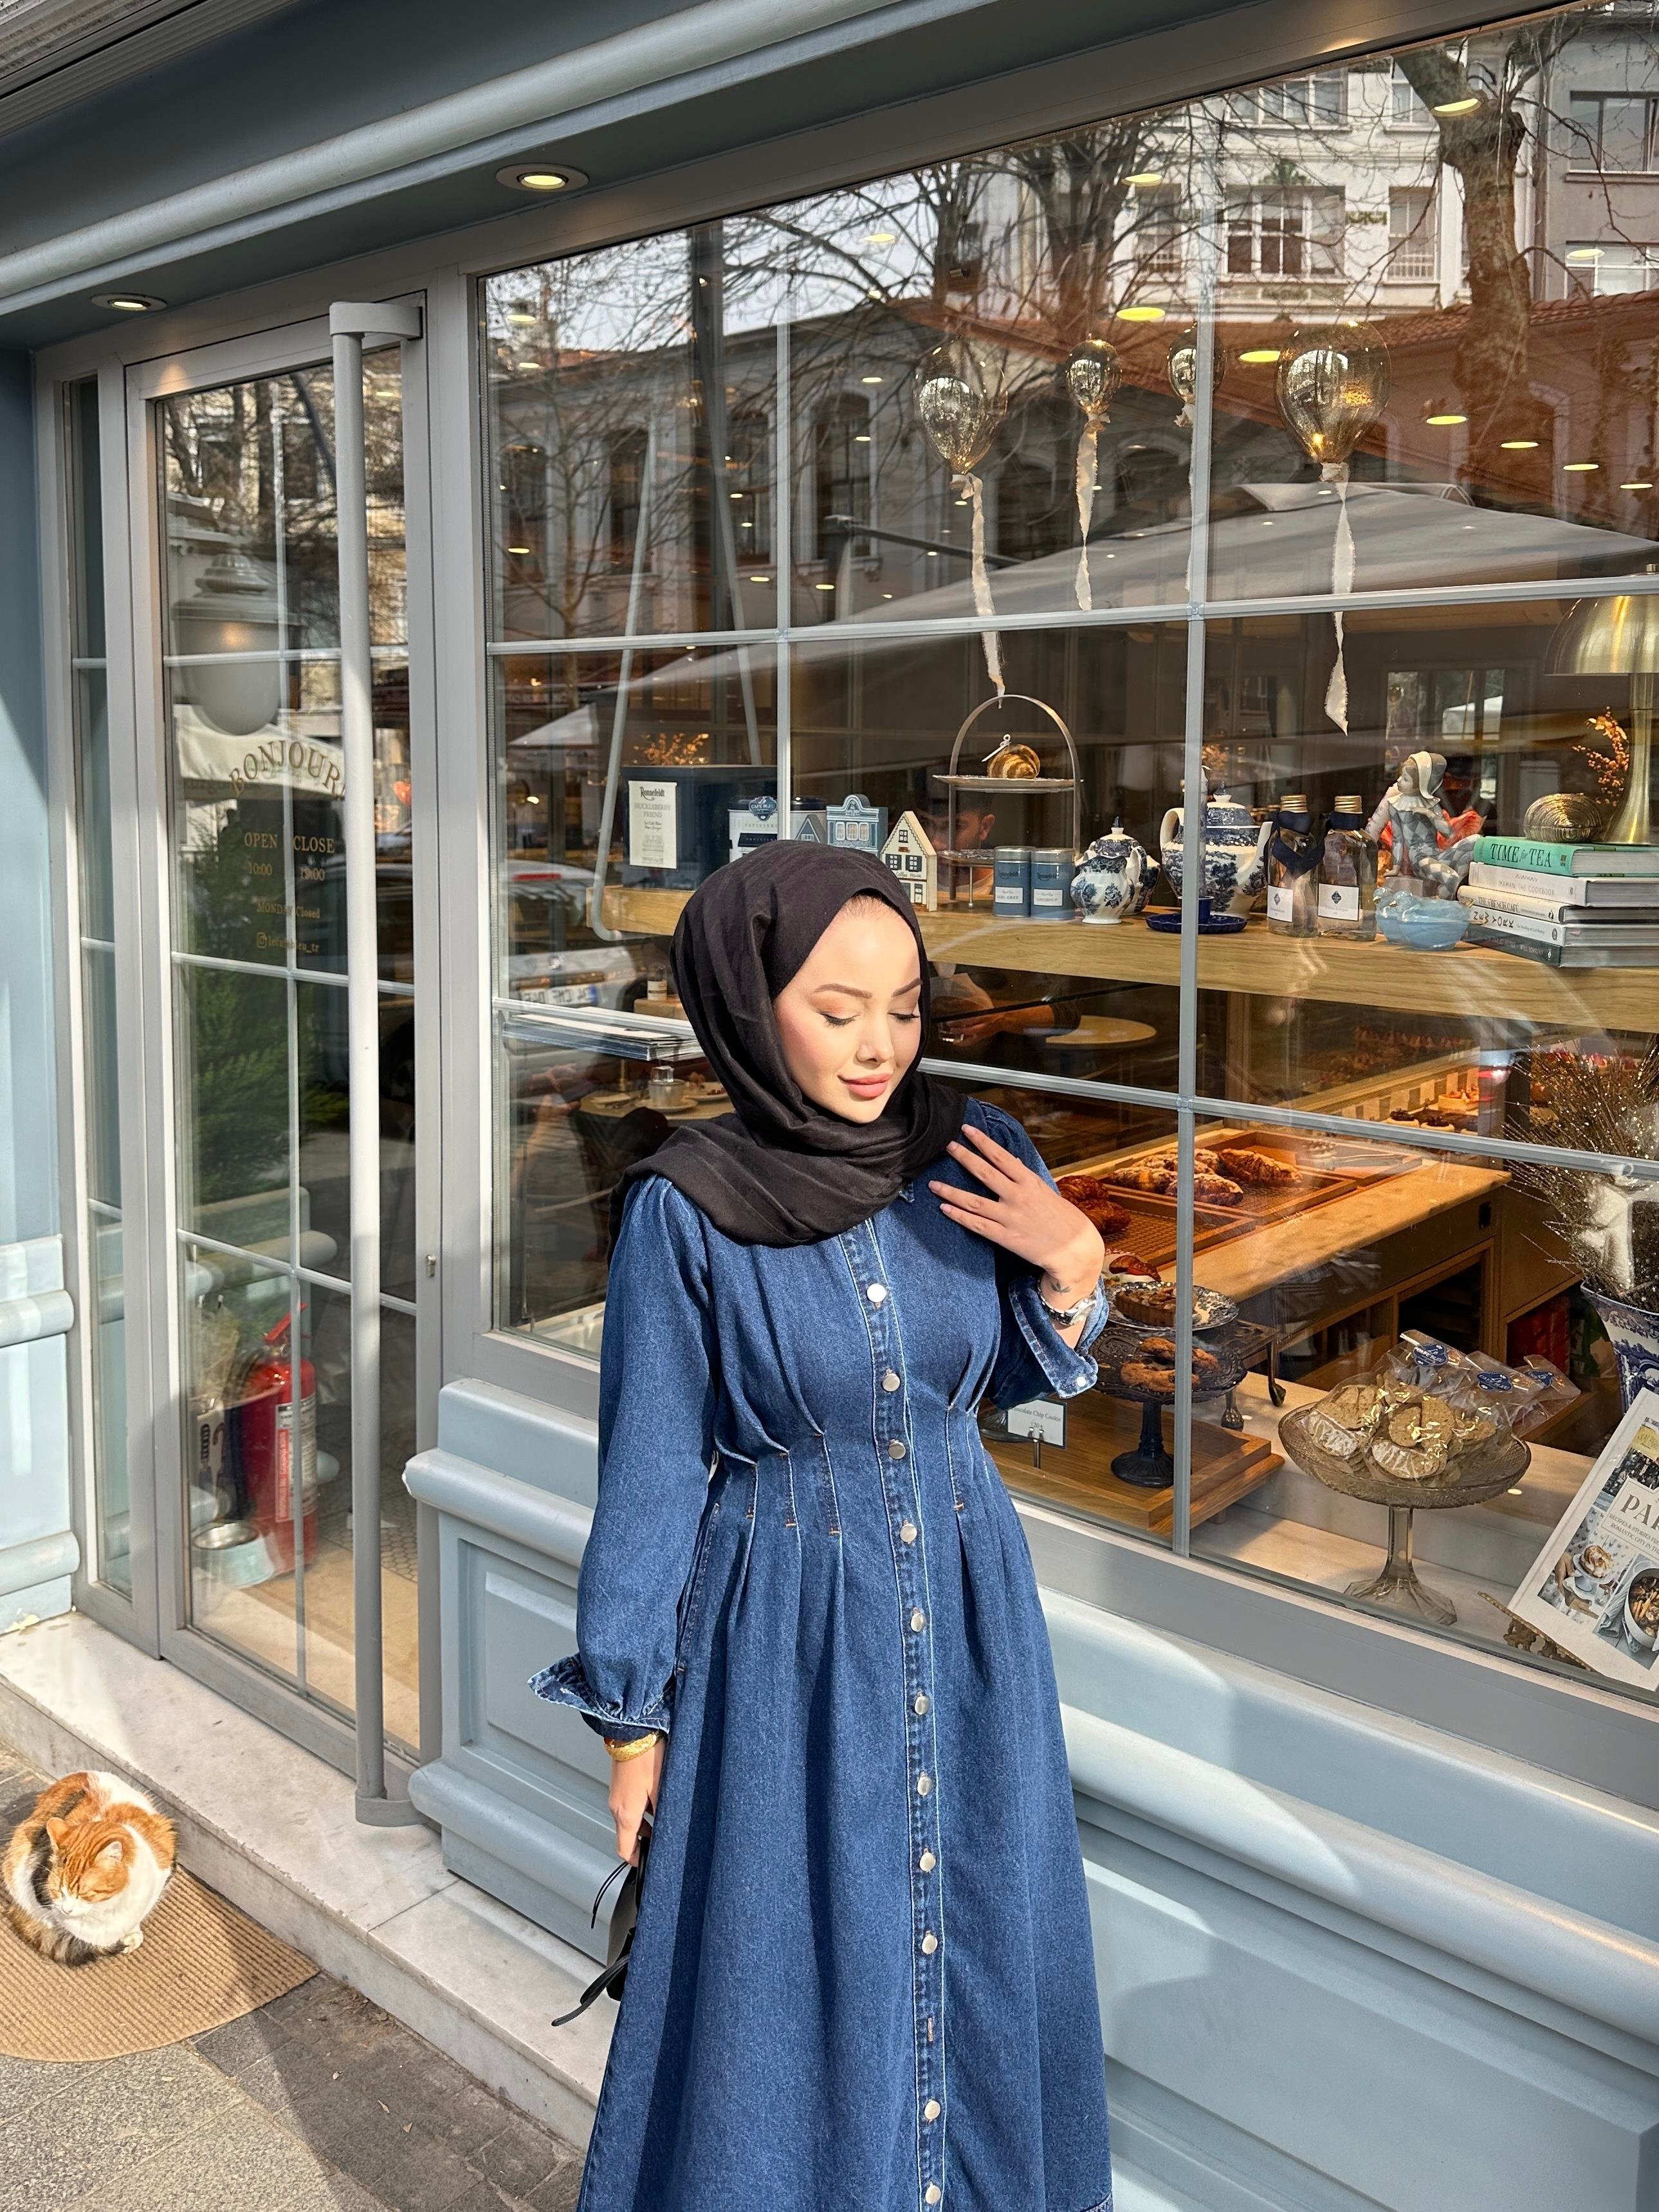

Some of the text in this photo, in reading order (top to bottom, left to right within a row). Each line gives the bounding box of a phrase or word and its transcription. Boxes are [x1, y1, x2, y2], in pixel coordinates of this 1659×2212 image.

[229, 740, 342, 798] BONJOUR
[244, 832, 335, 854] OPEN CLOSE
[1490, 843, 1520, 863] TIME
[1528, 848, 1552, 868] TEA
[248, 862, 273, 876] 10:00
[296, 906, 320, 919] Closed
[1492, 916, 1514, 928] YORK
